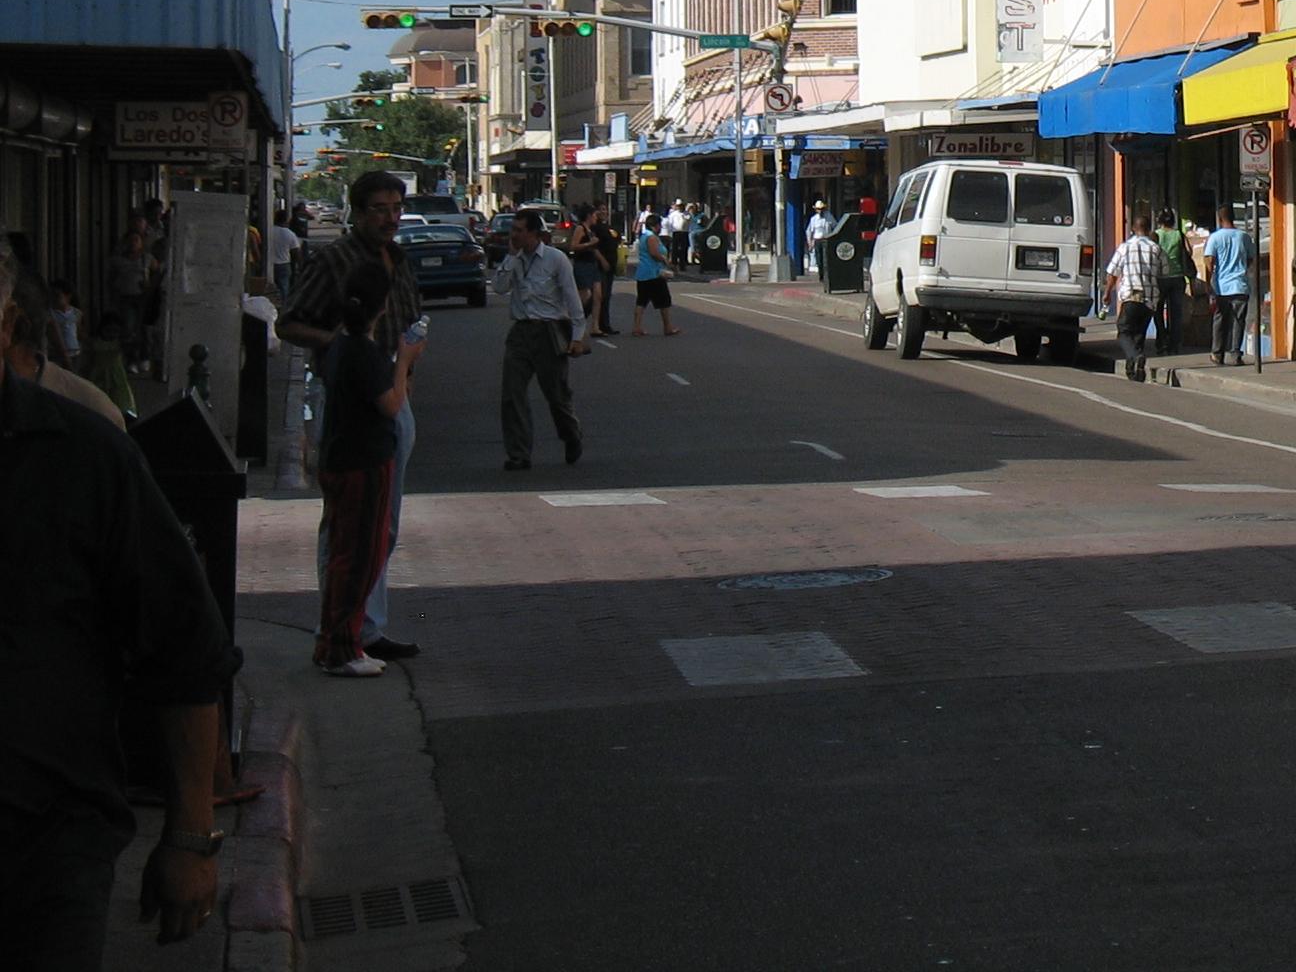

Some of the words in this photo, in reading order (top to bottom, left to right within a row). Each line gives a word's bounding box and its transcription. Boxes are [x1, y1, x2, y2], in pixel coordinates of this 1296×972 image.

[124, 107, 159, 122] Los
[172, 107, 208, 123] Dos
[119, 124, 208, 143] Laredo's
[935, 135, 1025, 154] Zonalibre
